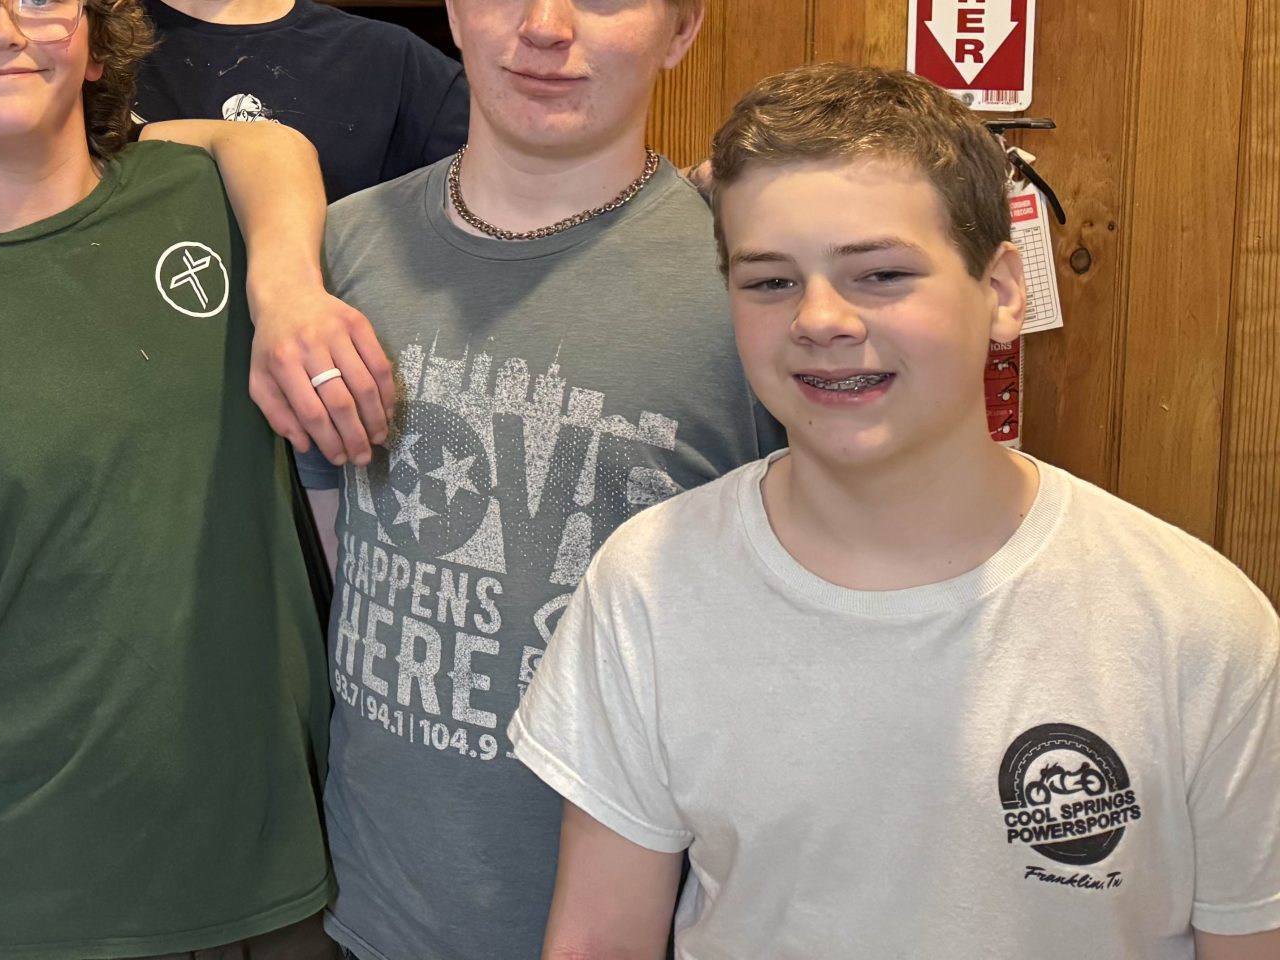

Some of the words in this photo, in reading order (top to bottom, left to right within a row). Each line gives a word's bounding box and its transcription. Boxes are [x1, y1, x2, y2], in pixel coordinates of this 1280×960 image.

[343, 531, 504, 635] HAPPENS
[335, 581, 501, 729] HERE
[366, 695, 404, 737] 94.1
[419, 718, 499, 761] 104.9
[1004, 807, 1058, 828] COOL
[1060, 790, 1136, 820] SPRINGS
[1007, 804, 1142, 844] POWERSPORTS
